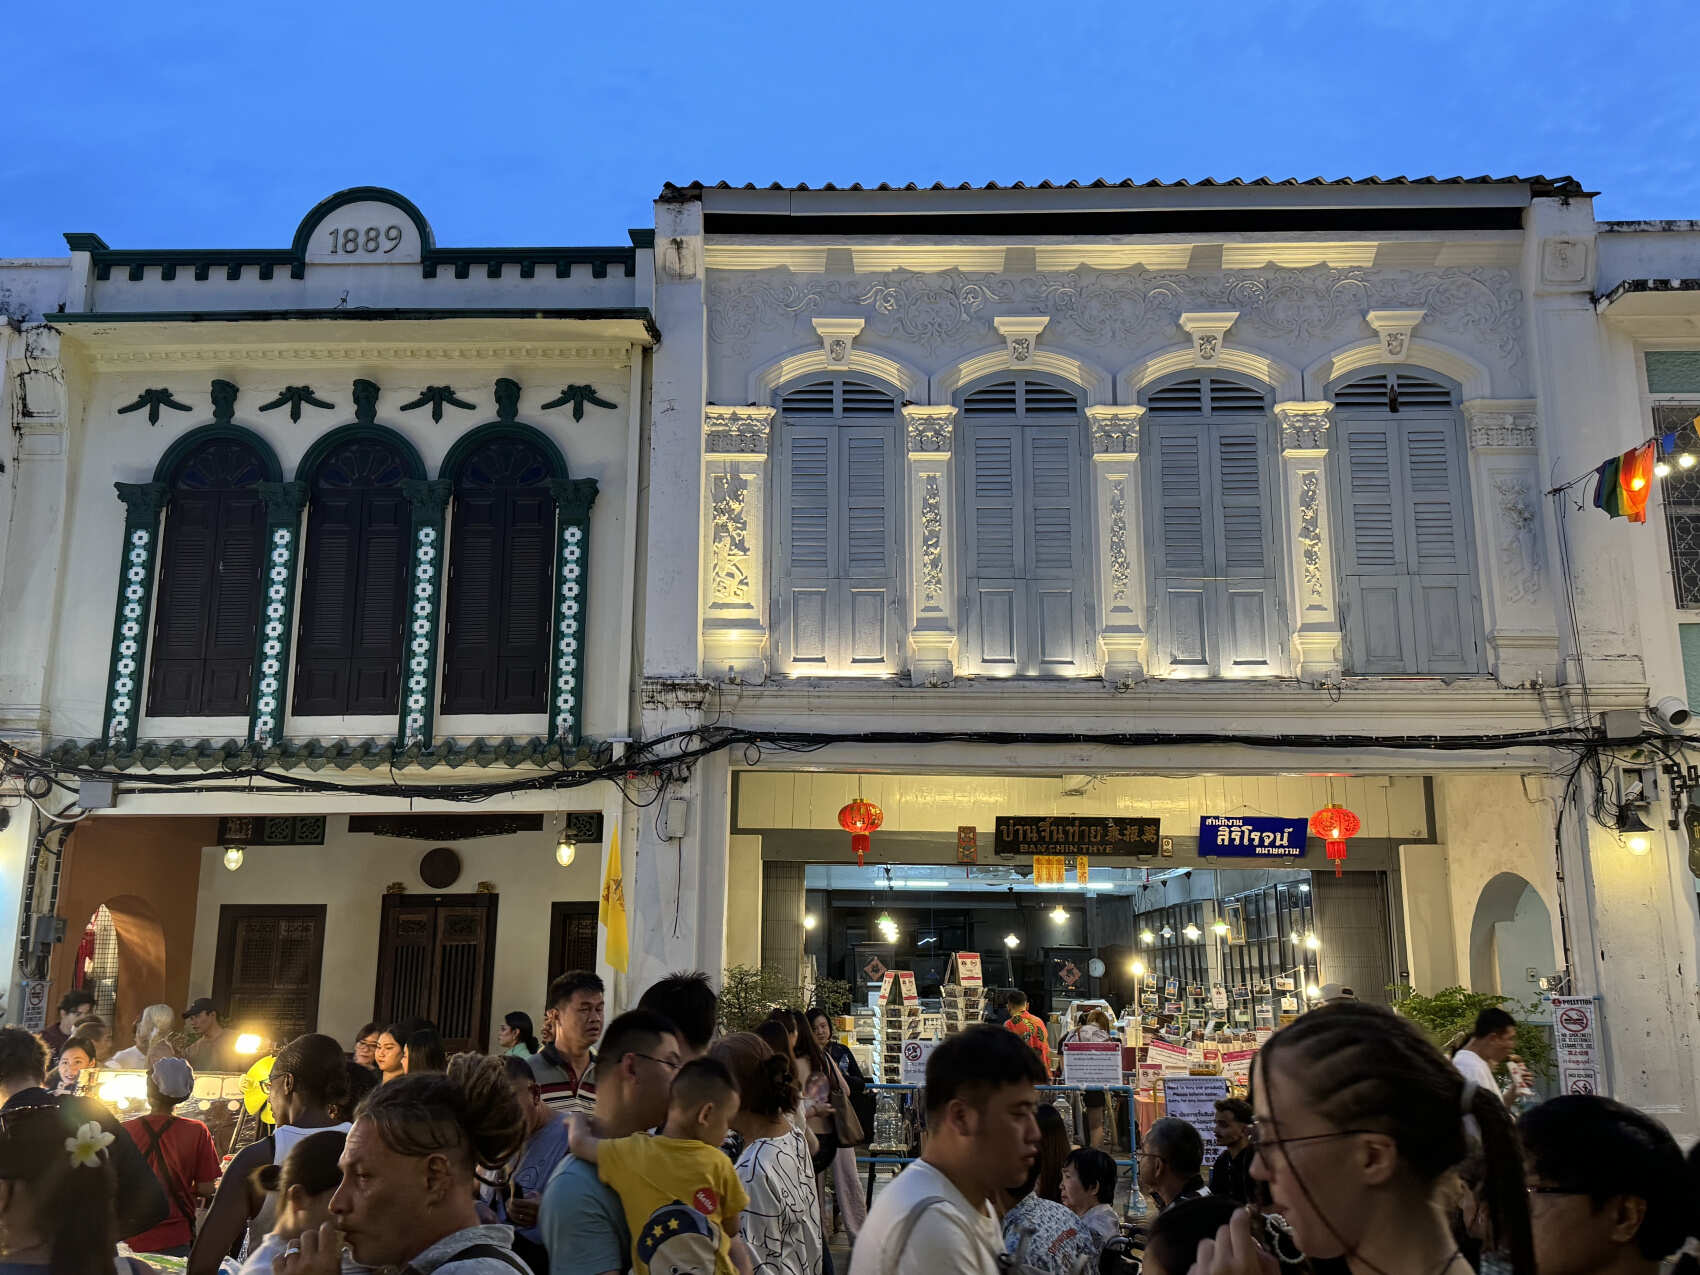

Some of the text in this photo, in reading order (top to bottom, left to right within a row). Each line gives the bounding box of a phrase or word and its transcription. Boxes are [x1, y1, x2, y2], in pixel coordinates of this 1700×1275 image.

[329, 225, 402, 254] 1889
[1217, 825, 1294, 846] สิริโรจน์
[1019, 844, 1113, 853] BAN CHIN THYE
[1255, 847, 1300, 855] ทนายความ
